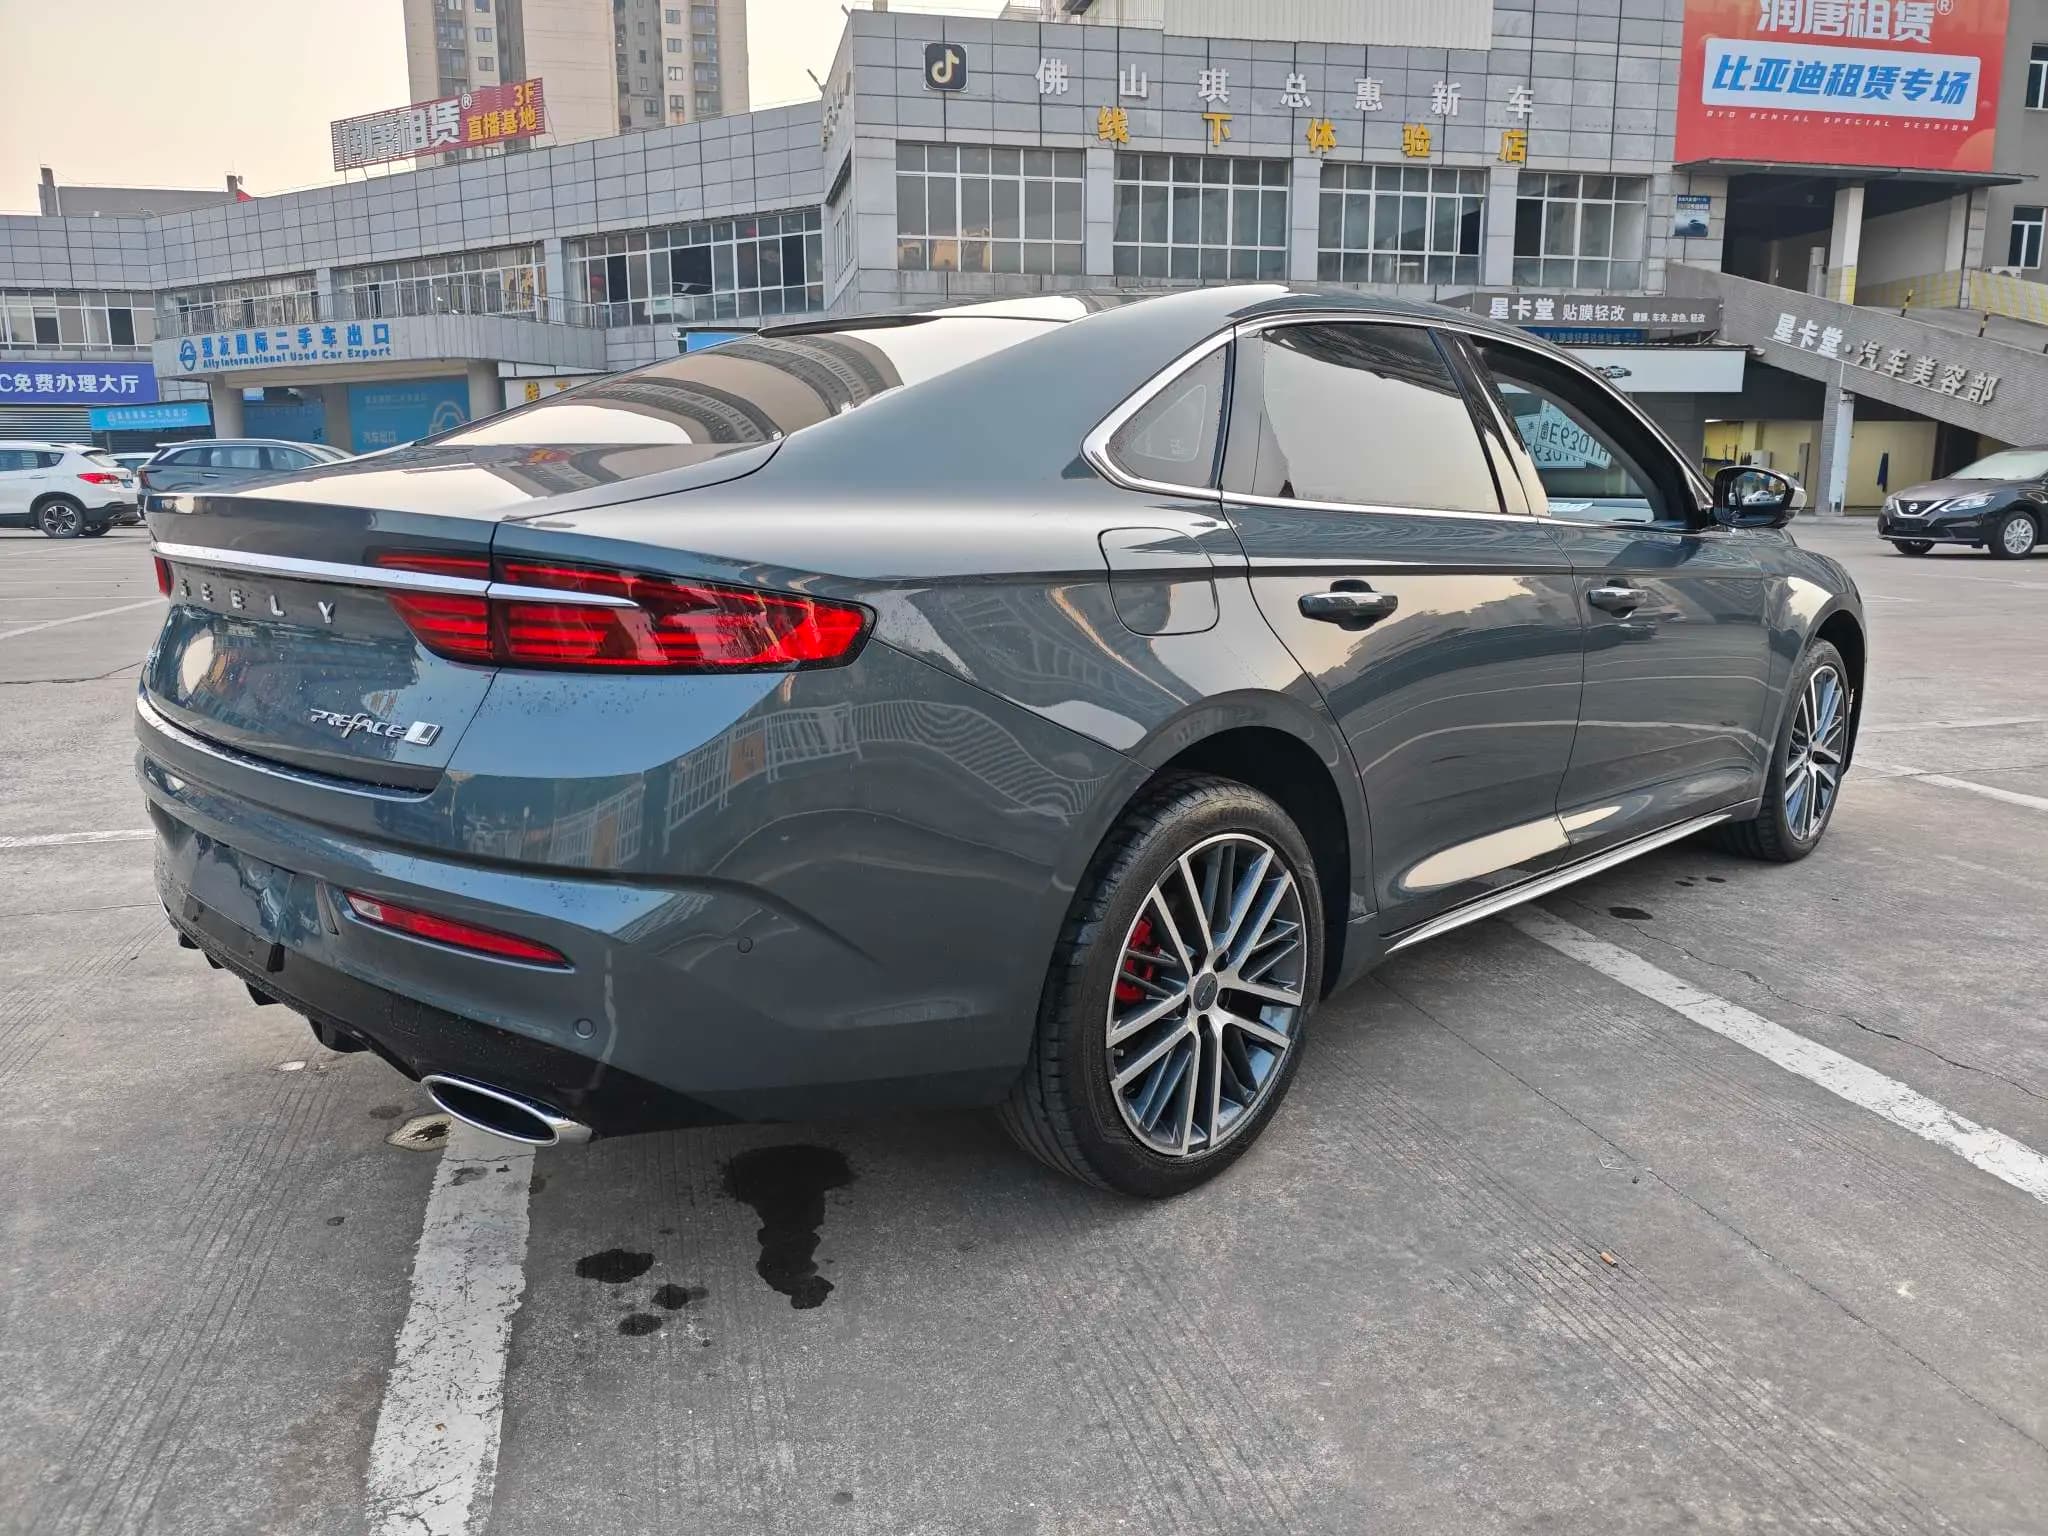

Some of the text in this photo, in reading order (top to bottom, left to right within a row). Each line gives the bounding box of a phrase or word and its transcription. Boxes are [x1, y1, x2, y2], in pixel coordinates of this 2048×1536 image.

[1757, 0, 1934, 43] 润唐租赁
[513, 83, 534, 106] 3F
[1035, 58, 1535, 119] 佛山琪总惠新车
[1712, 54, 1971, 104] 比亚迪租赁专场
[467, 105, 535, 142] 直播基地
[1097, 105, 1528, 163] 线下体验店
[1706, 110, 1970, 132] BYD RENTAL SPECIAL SESSION
[1489, 297, 1555, 320] 星卡堂
[1562, 304, 1626, 322] 贴膜轻改
[290, 350, 317, 361] Used
[321, 349, 342, 360] Car
[347, 346, 391, 359] Export
